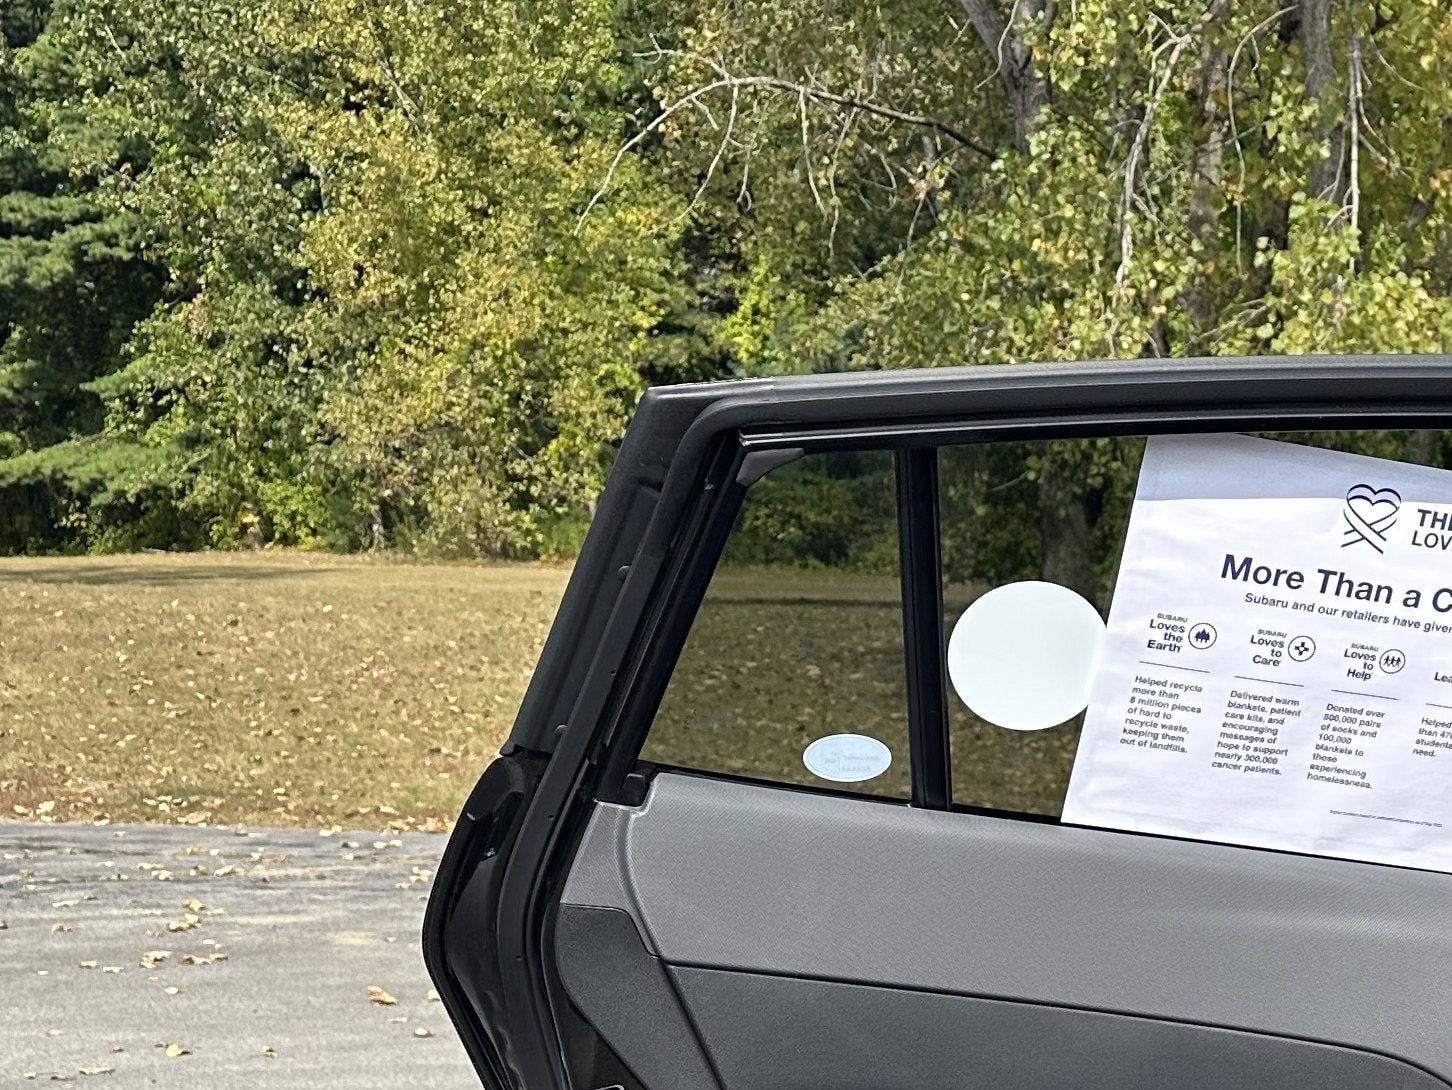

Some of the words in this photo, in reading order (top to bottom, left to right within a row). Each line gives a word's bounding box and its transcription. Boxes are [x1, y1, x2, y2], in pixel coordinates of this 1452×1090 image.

[1221, 554, 1305, 590] More
[1318, 569, 1393, 604] Than
[1403, 590, 1422, 609] a
[1245, 593, 1289, 609] Subaru
[1292, 602, 1316, 613] and
[1318, 606, 1339, 616] our
[1341, 610, 1390, 624] retailers
[1393, 616, 1421, 629] have
[1150, 619, 1185, 633] Loves
[1164, 632, 1183, 643] the
[1250, 635, 1284, 648] Loves
[1147, 640, 1182, 653] Earth
[1271, 649, 1282, 658] to
[1344, 649, 1376, 662] Loves
[1253, 655, 1282, 667] Care
[1363, 662, 1374, 671] to
[1347, 668, 1372, 682] Help
